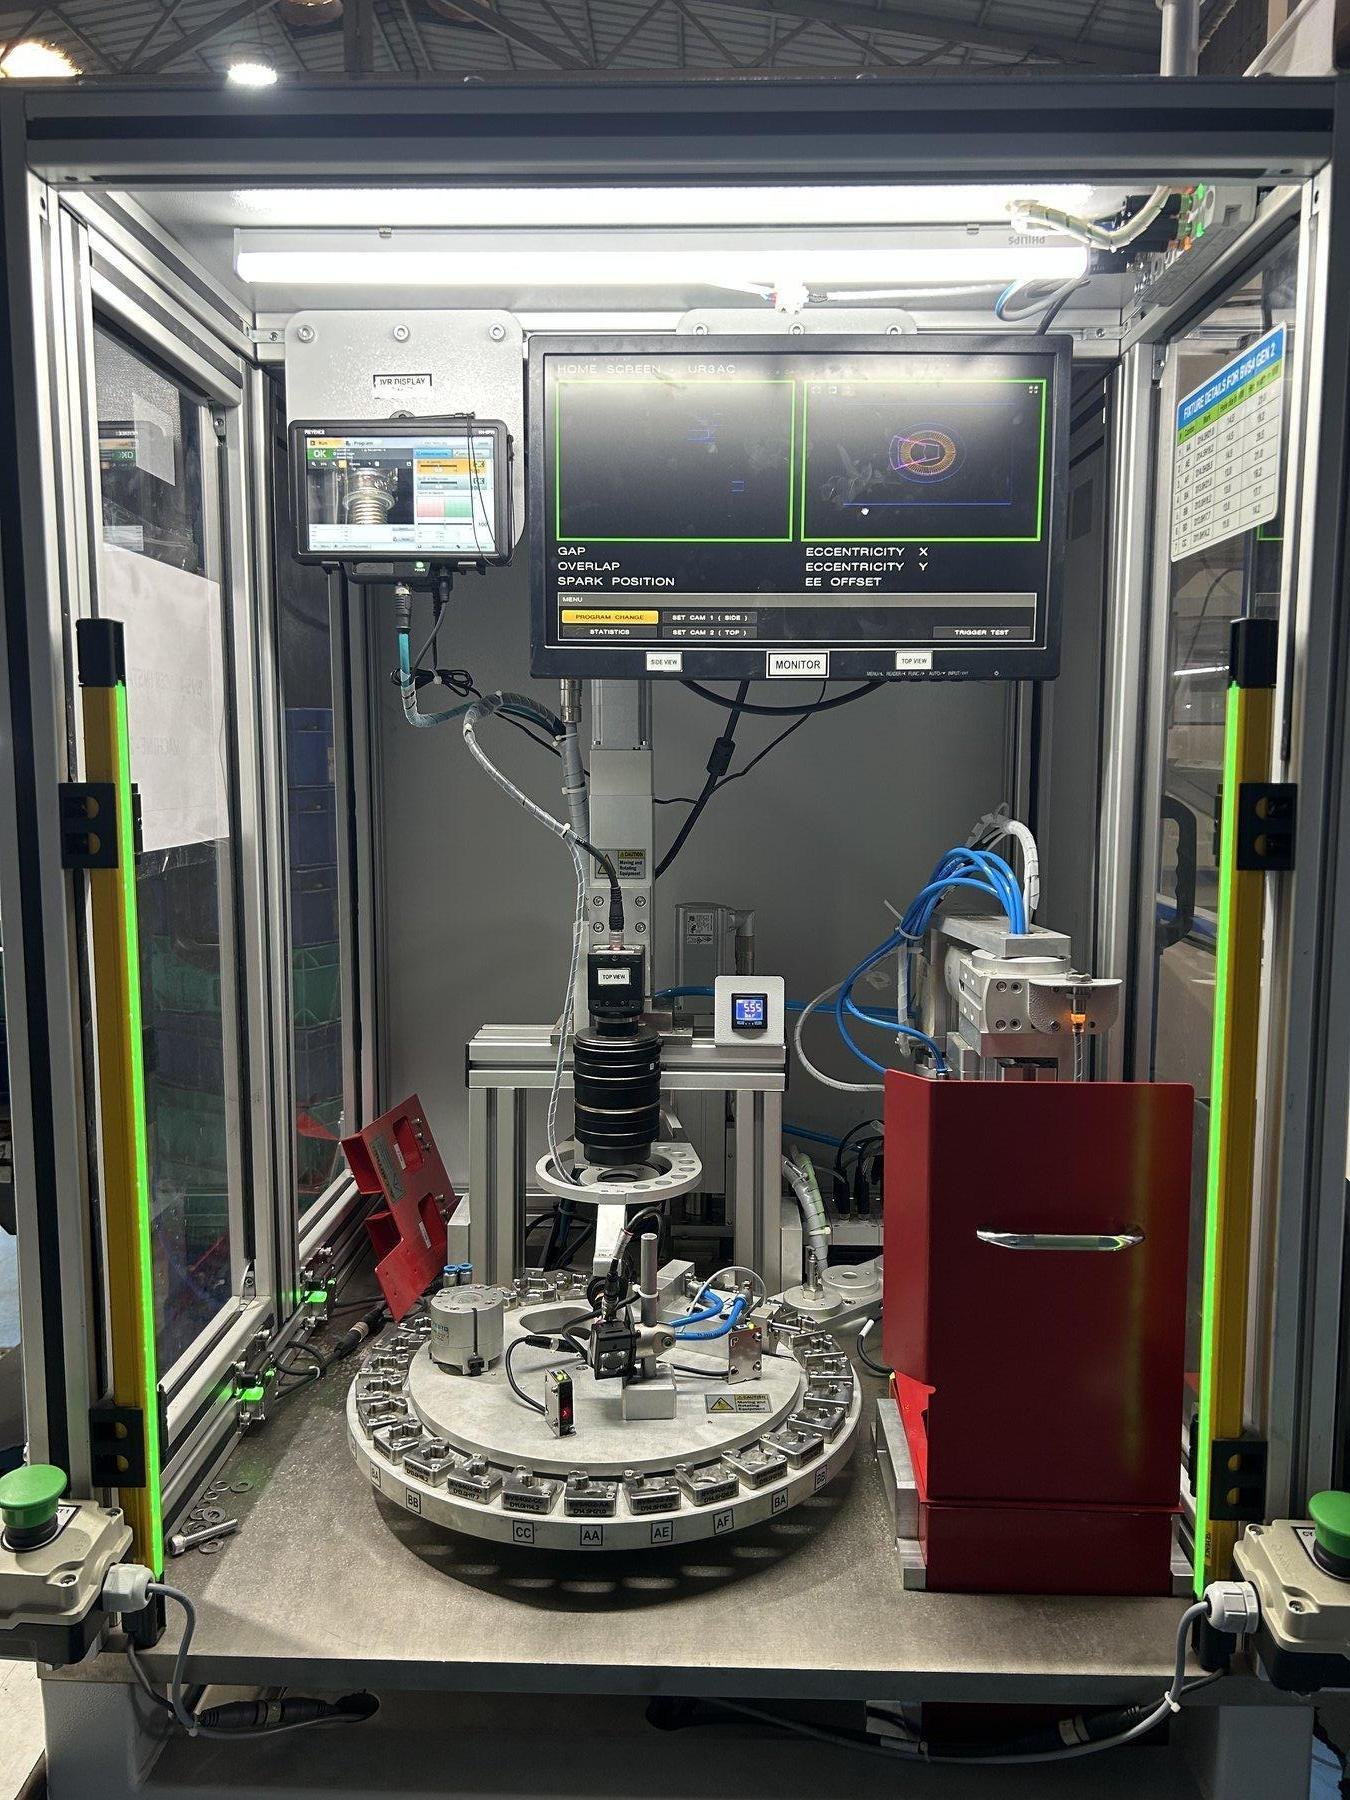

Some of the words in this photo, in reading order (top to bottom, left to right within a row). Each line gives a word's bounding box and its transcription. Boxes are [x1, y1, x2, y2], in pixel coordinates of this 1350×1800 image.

[1008, 235, 1046, 245] PHILIPS
[557, 364, 598, 374] HOME
[607, 364, 660, 374] SCREEN
[558, 546, 586, 556] GAP
[806, 547, 905, 556] ECCENTRICITY
[919, 548, 928, 556] X
[558, 562, 620, 570] OVERLAP
[805, 562, 904, 571] ECCENTRICITY
[918, 562, 928, 571] Y
[558, 576, 603, 586] SPARK
[612, 576, 675, 586] POSITION
[805, 577, 822, 586] EE
[830, 577, 882, 586] OFFSET
[776, 660, 821, 669] MONITOR
[408, 1494, 418, 1507] BB
[775, 1495, 786, 1507] BA
[716, 1515, 730, 1528] AF
[516, 1527, 531, 1538] CC
[583, 1530, 600, 1540] AA
[654, 1527, 670, 1538] AE
